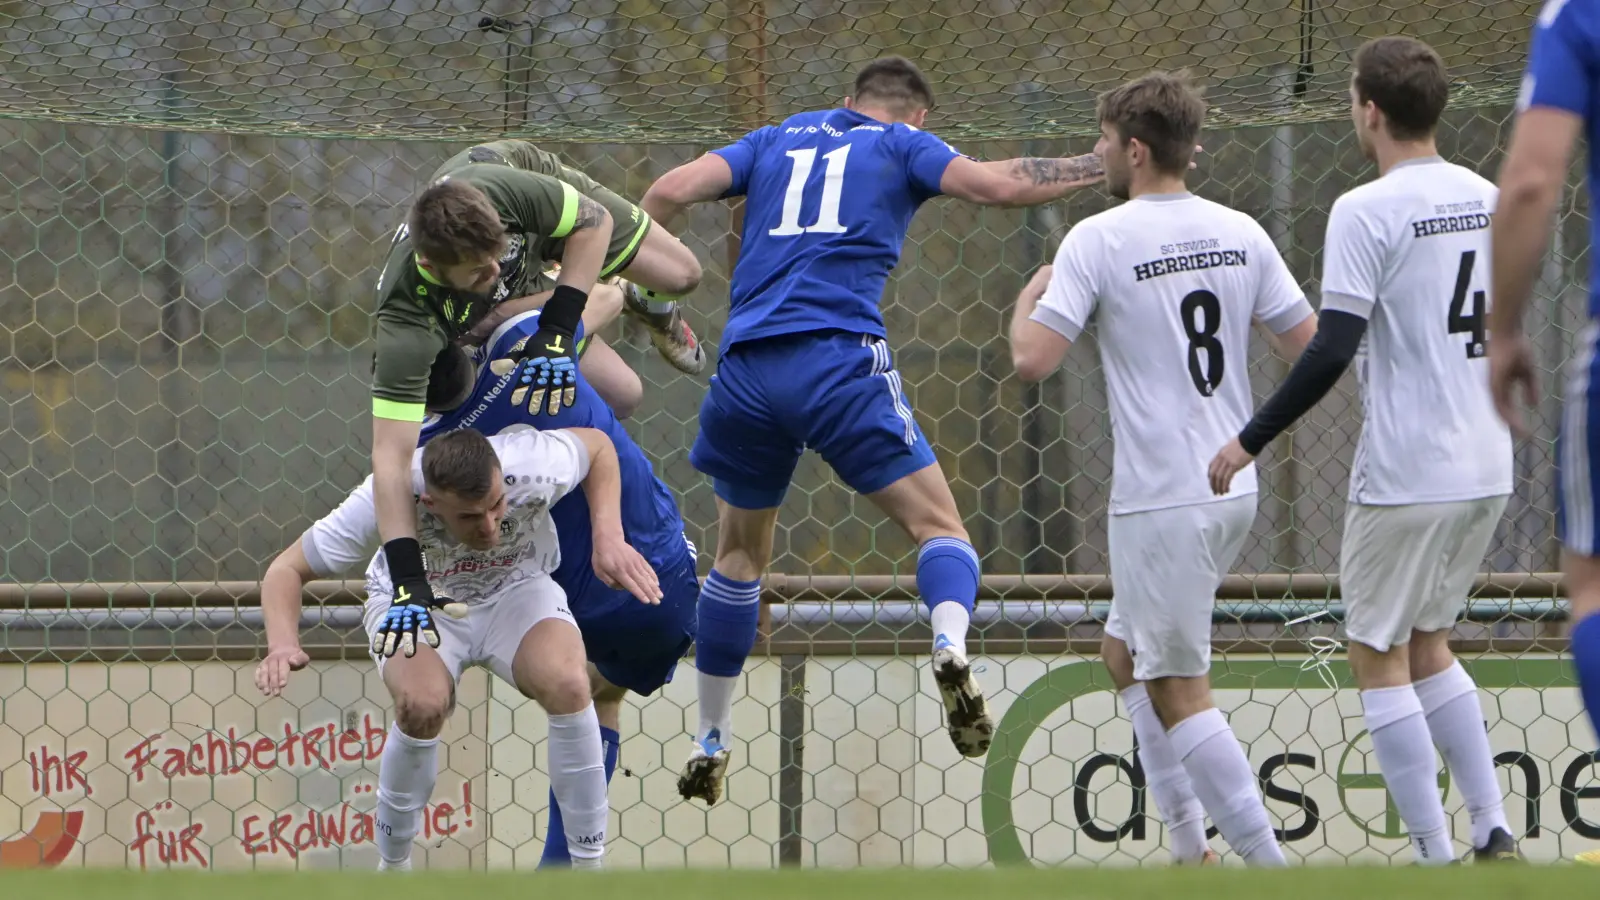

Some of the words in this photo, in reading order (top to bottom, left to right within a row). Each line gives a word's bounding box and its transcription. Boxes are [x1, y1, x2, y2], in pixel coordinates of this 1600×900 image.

[768, 143, 852, 237] 11
[1160, 244, 1176, 256] SG
[1176, 238, 1221, 253] TSV/DJK
[1412, 212, 1496, 239] HERRIED
[1133, 250, 1248, 282] HERRIEDEN
[1447, 250, 1490, 359] 4
[1180, 289, 1225, 398] 8
[1073, 721, 1320, 843] ds
[576, 831, 604, 845] JAKO
